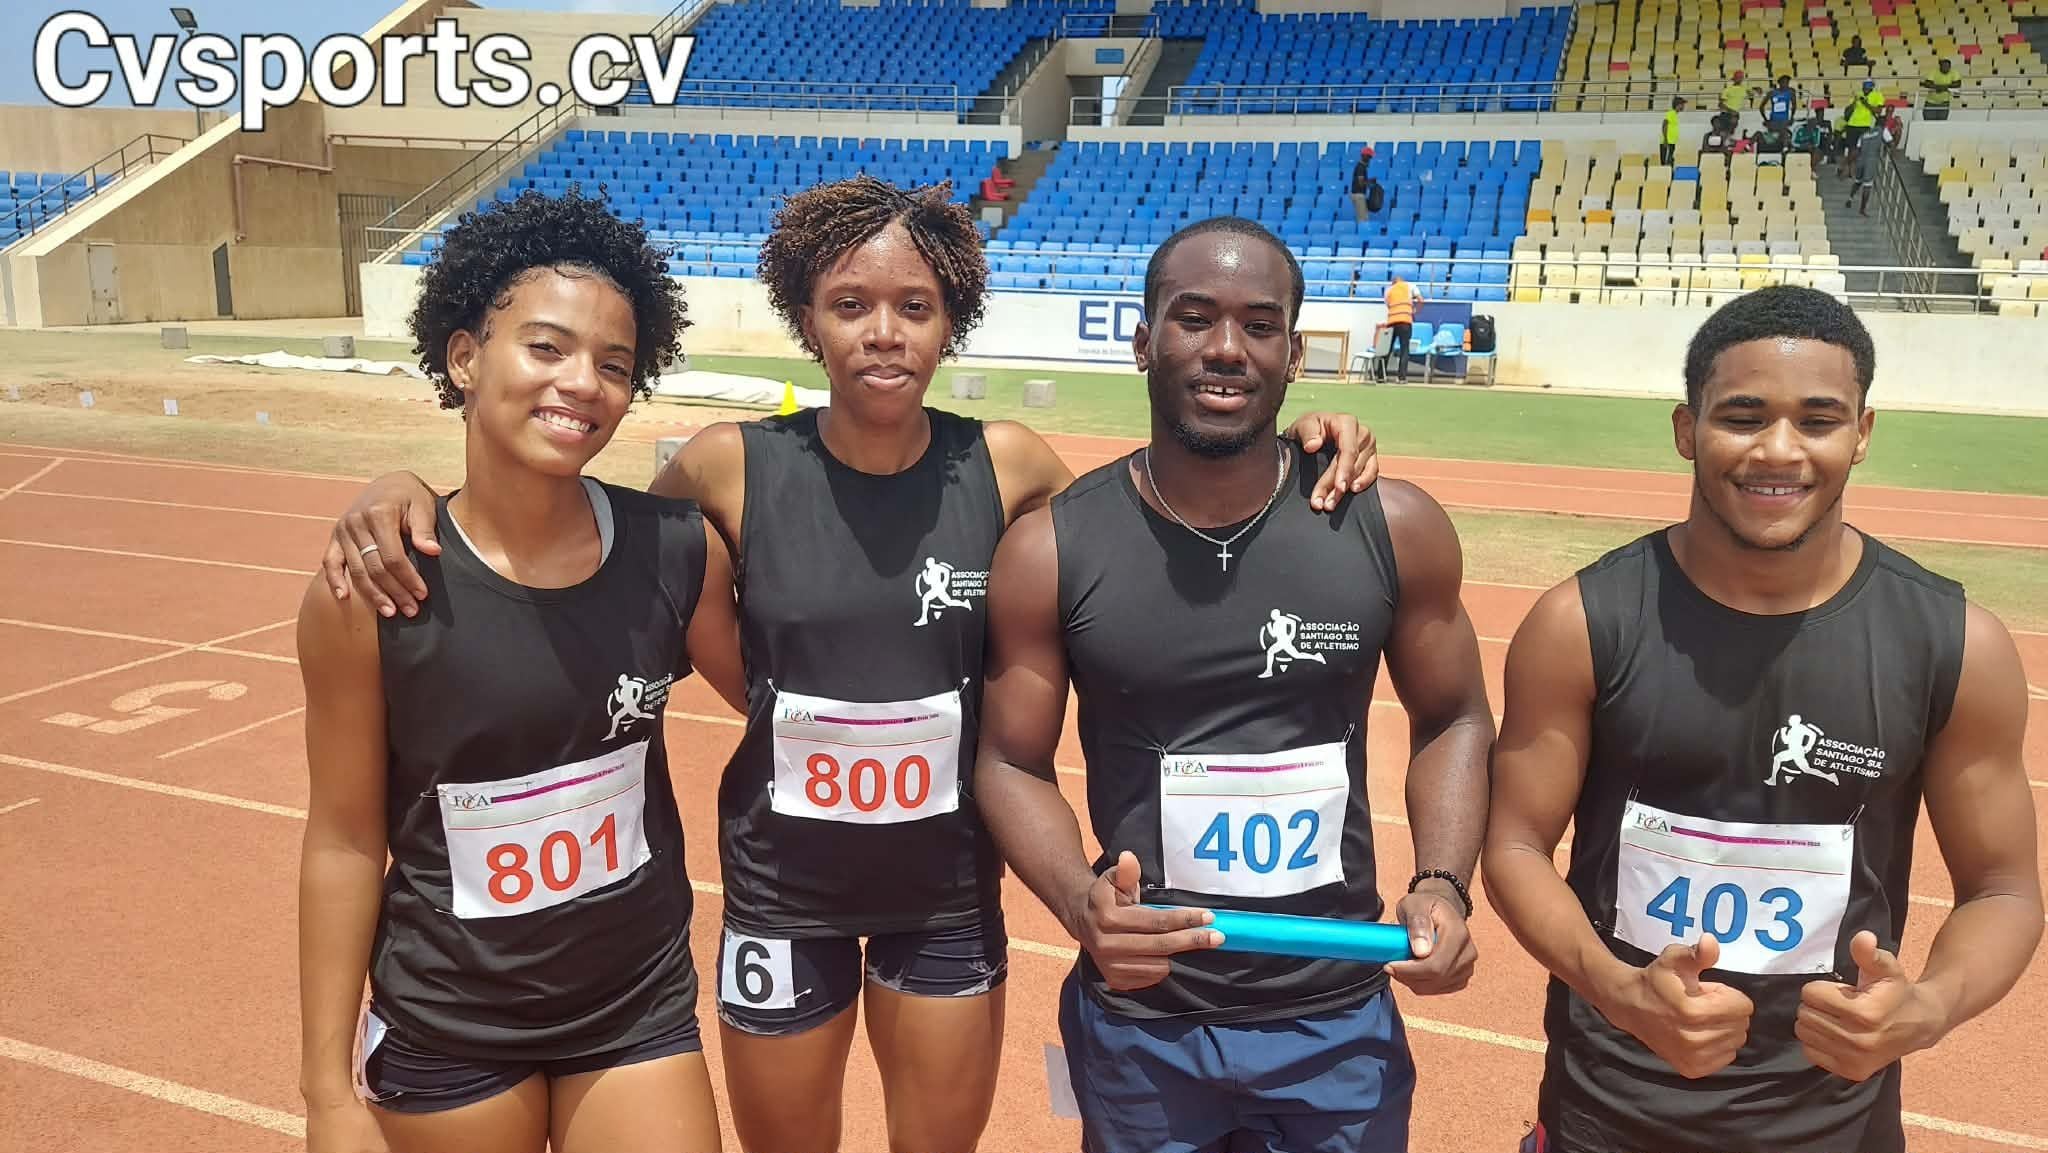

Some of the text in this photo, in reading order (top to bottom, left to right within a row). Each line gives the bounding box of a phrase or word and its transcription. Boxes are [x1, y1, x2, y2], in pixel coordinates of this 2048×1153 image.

[951, 580, 982, 588] SANTIAGO
[952, 589, 962, 597] DE
[1299, 621, 1360, 633] ASSOCIAÇÃO
[1300, 632, 1360, 641] SANTIAGO SUL
[1300, 641, 1360, 650] DE ATLETISMO
[1815, 747, 1884, 770] SANTIAGO SUL
[1818, 738, 1886, 759] ASSOCIAÇÃO
[1814, 757, 1881, 778] DE ATLETISMO
[805, 752, 931, 812] 800
[1194, 808, 1320, 874] 402
[486, 812, 619, 904] 801
[1646, 875, 1804, 952] 403
[735, 941, 774, 1004] 6
